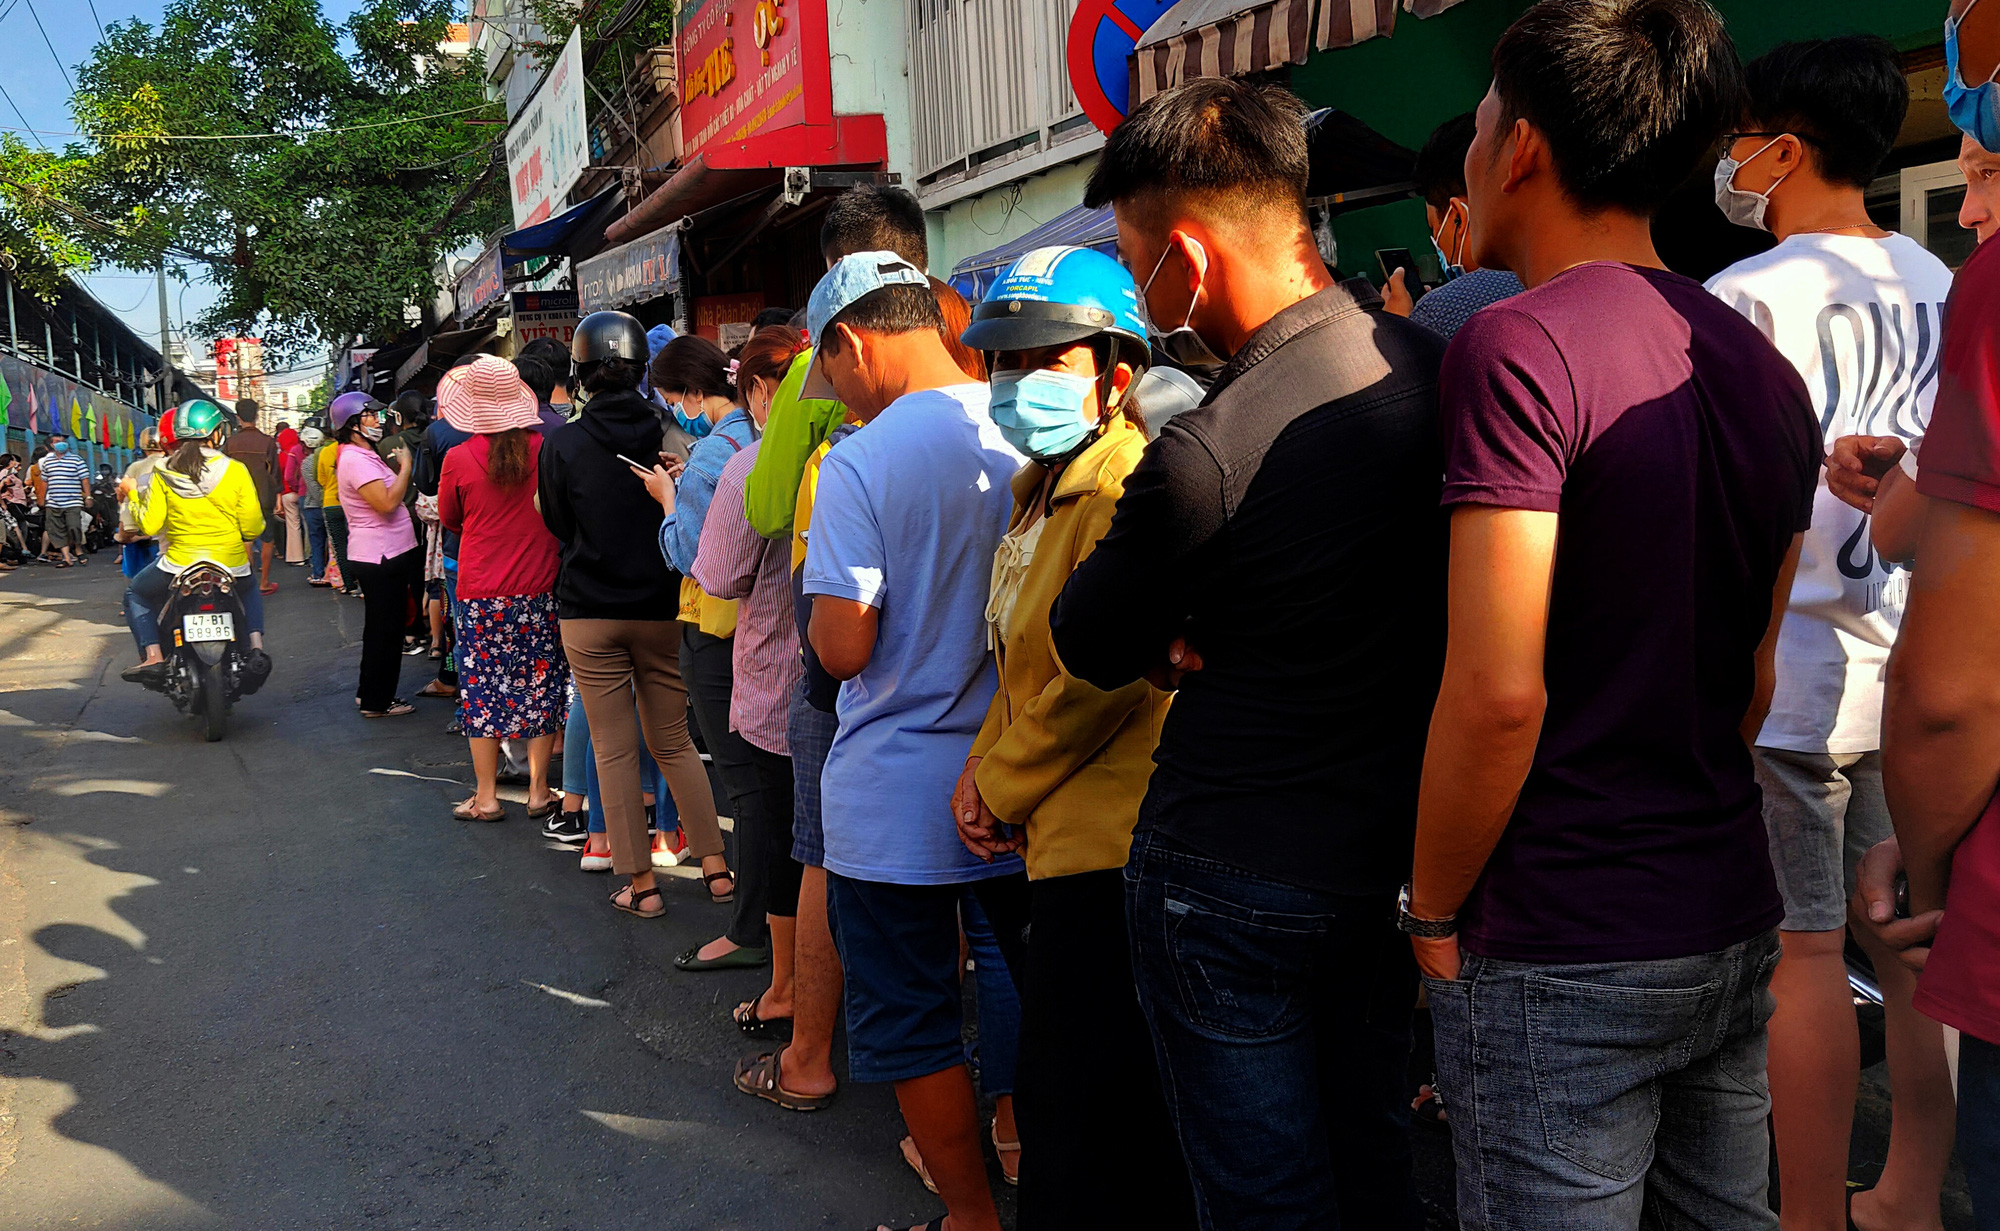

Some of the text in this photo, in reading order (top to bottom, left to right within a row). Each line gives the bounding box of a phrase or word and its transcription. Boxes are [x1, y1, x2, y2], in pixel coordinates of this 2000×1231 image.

[696, 304, 714, 326] Nhà
[192, 615, 224, 626] 47-B1
[188, 627, 231, 639] 589.86
